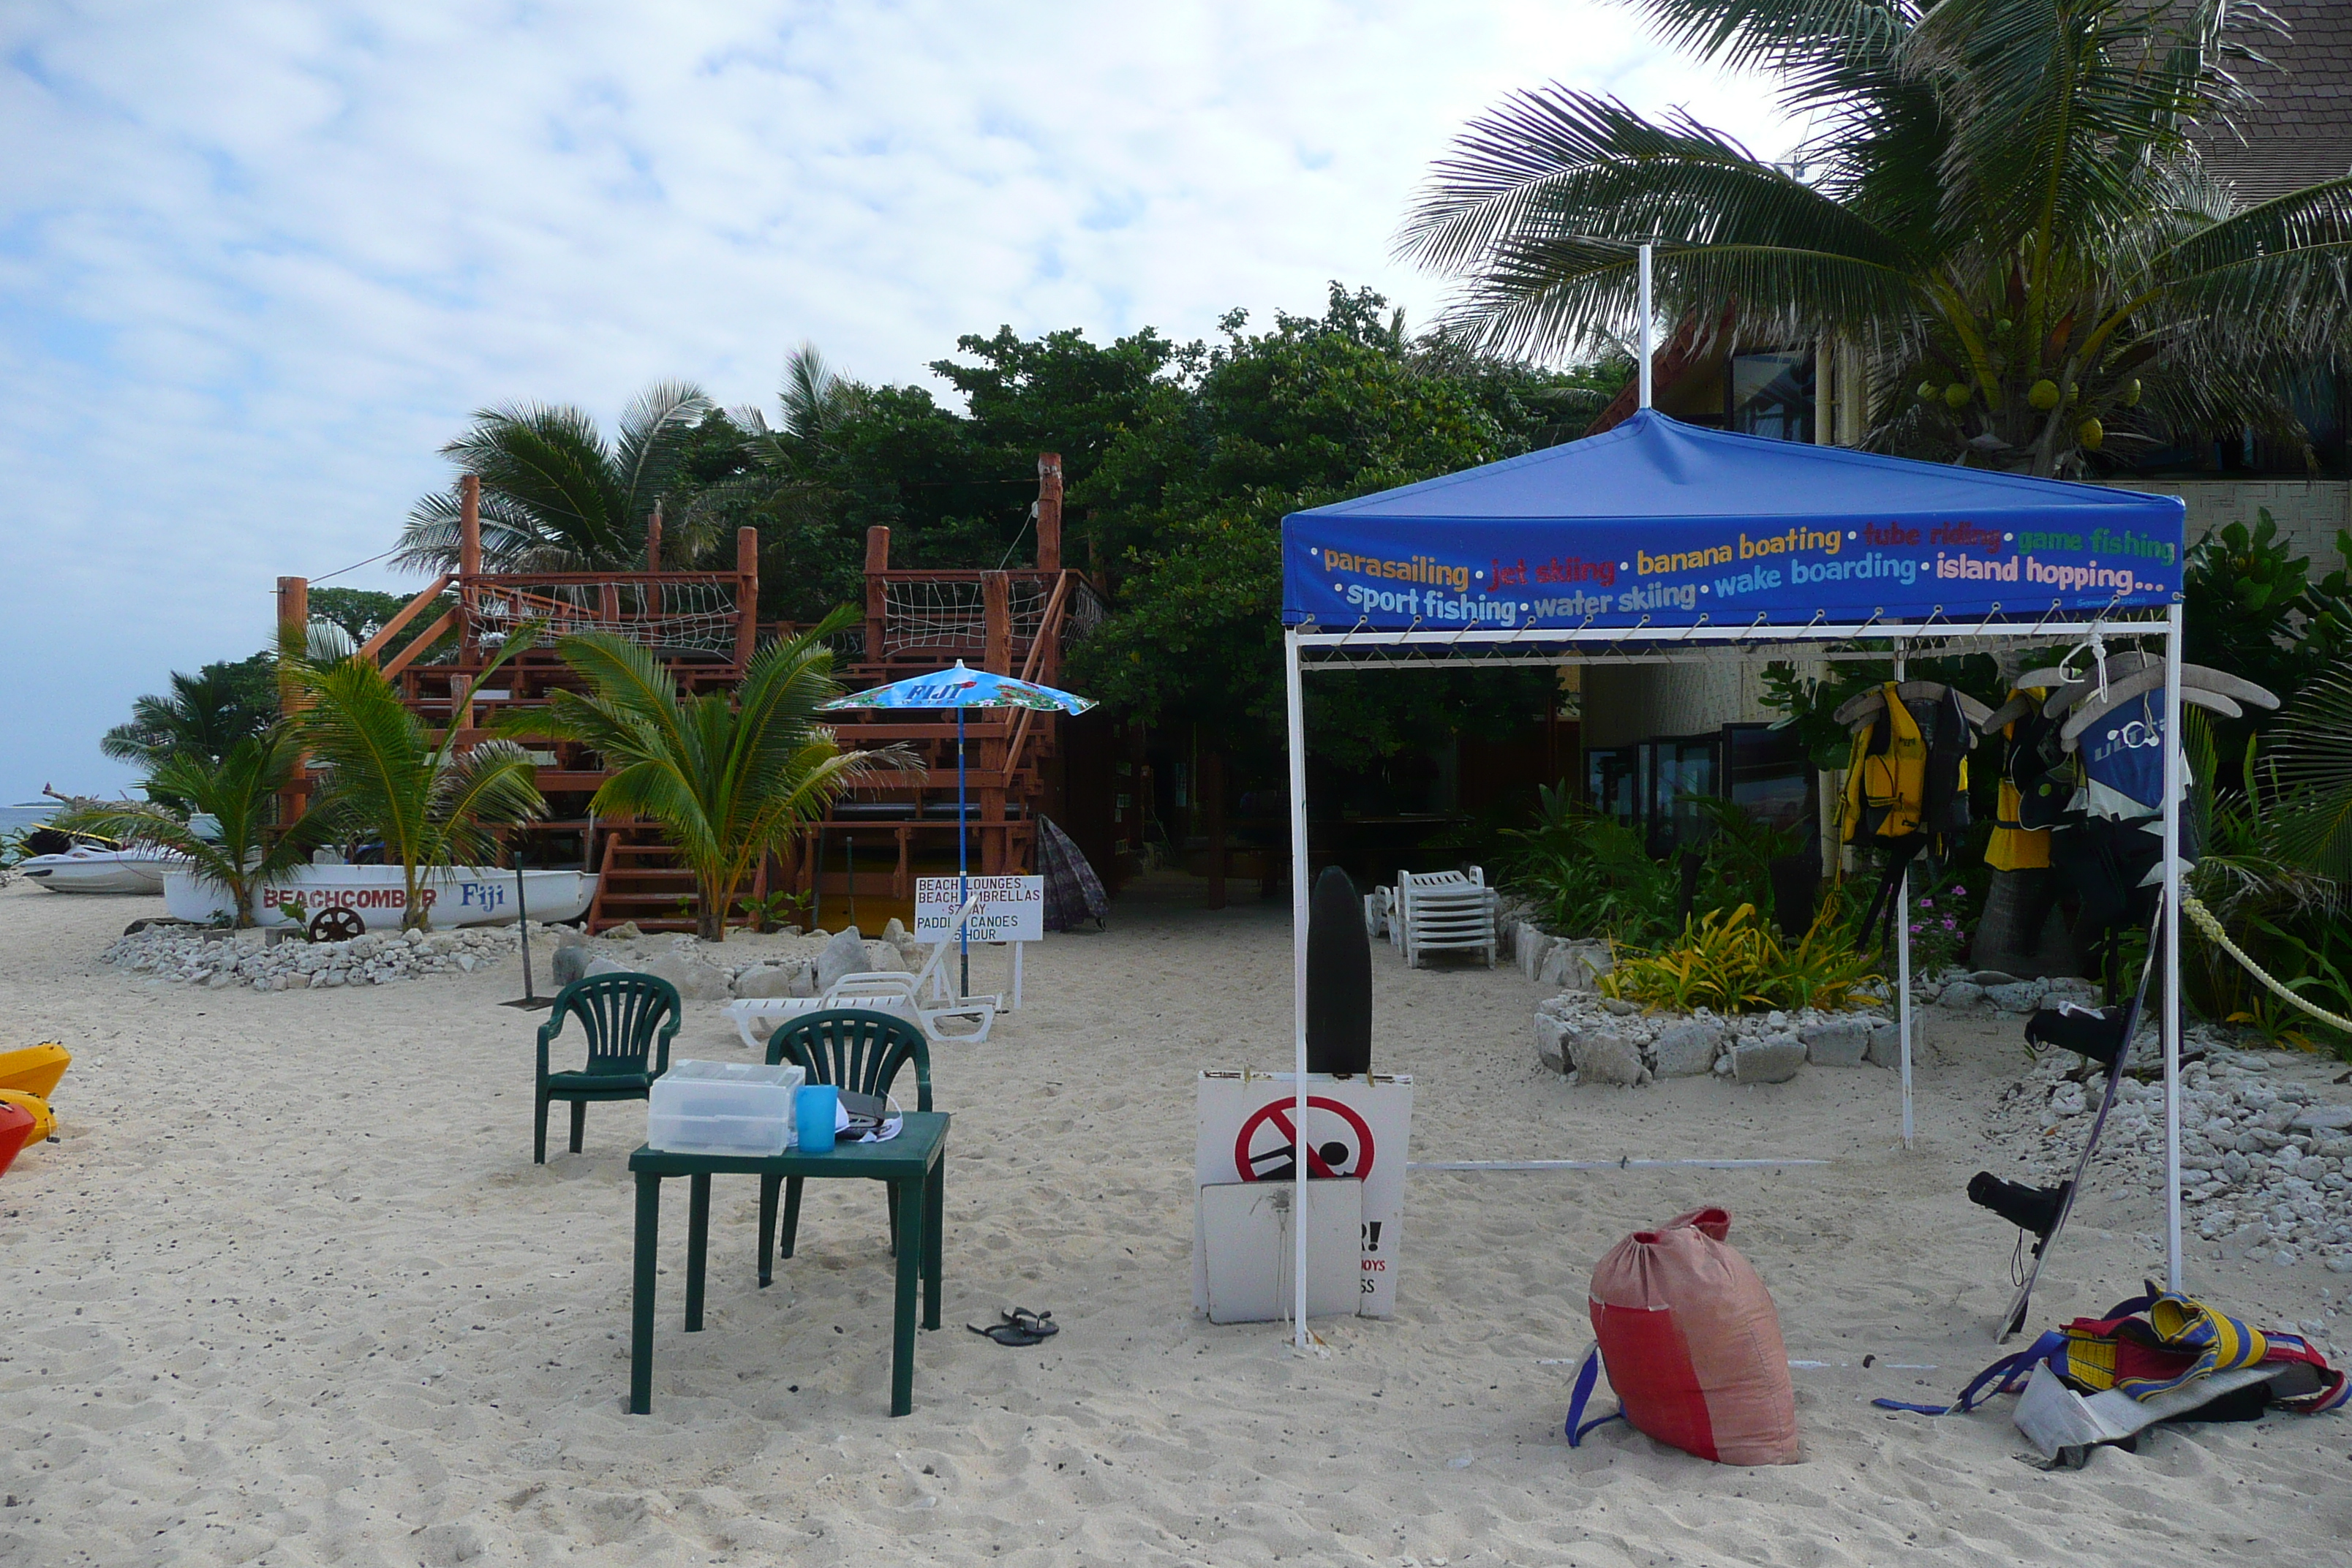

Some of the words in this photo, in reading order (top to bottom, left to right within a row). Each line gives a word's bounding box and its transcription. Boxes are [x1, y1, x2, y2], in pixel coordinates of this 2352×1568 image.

[1324, 548, 1470, 593] parasailing
[1486, 558, 1529, 593] jet
[1535, 556, 1616, 587] skiing
[1637, 543, 1733, 576] banana
[1740, 527, 1842, 559] boating
[1862, 521, 1921, 548] tube
[1930, 521, 2002, 554] riding
[2017, 529, 2083, 555] game
[2089, 527, 2176, 566] fishing
[1346, 583, 1420, 614] sport
[1424, 590, 1518, 628] fishing
[1534, 592, 1614, 619] water
[1618, 581, 1697, 611] skiing
[1714, 563, 1782, 598] wake
[1791, 553, 1918, 585] boarding
[1936, 551, 2019, 582] island
[905, 684, 964, 700] FIJI
[919, 879, 959, 891] BEACH
[263, 888, 438, 909] BEACHCOMBR
[460, 882, 507, 913] Fiji
[919, 892, 959, 903] BEACH
[970, 915, 1019, 928] CANOES
[965, 928, 997, 941] HOUR
